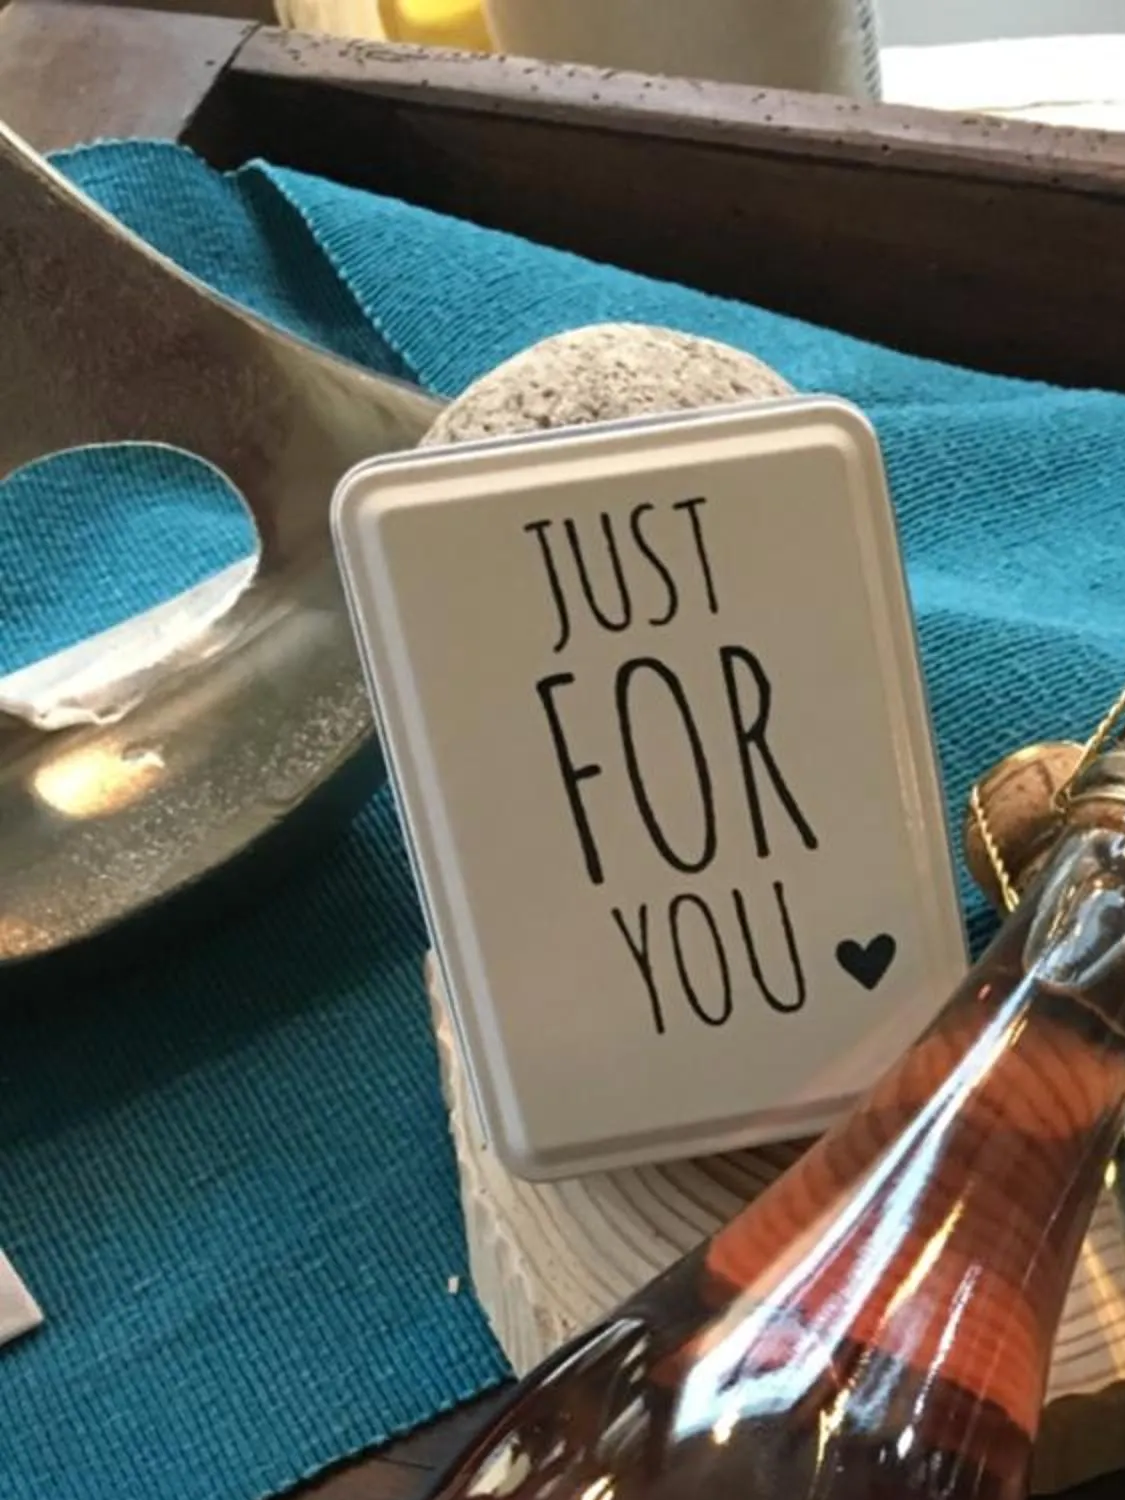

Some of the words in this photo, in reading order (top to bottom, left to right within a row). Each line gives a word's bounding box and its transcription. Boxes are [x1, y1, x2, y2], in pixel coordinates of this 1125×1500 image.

[523, 497, 719, 653] JUST
[536, 645, 818, 885] FOR
[612, 881, 806, 1034] YOU
